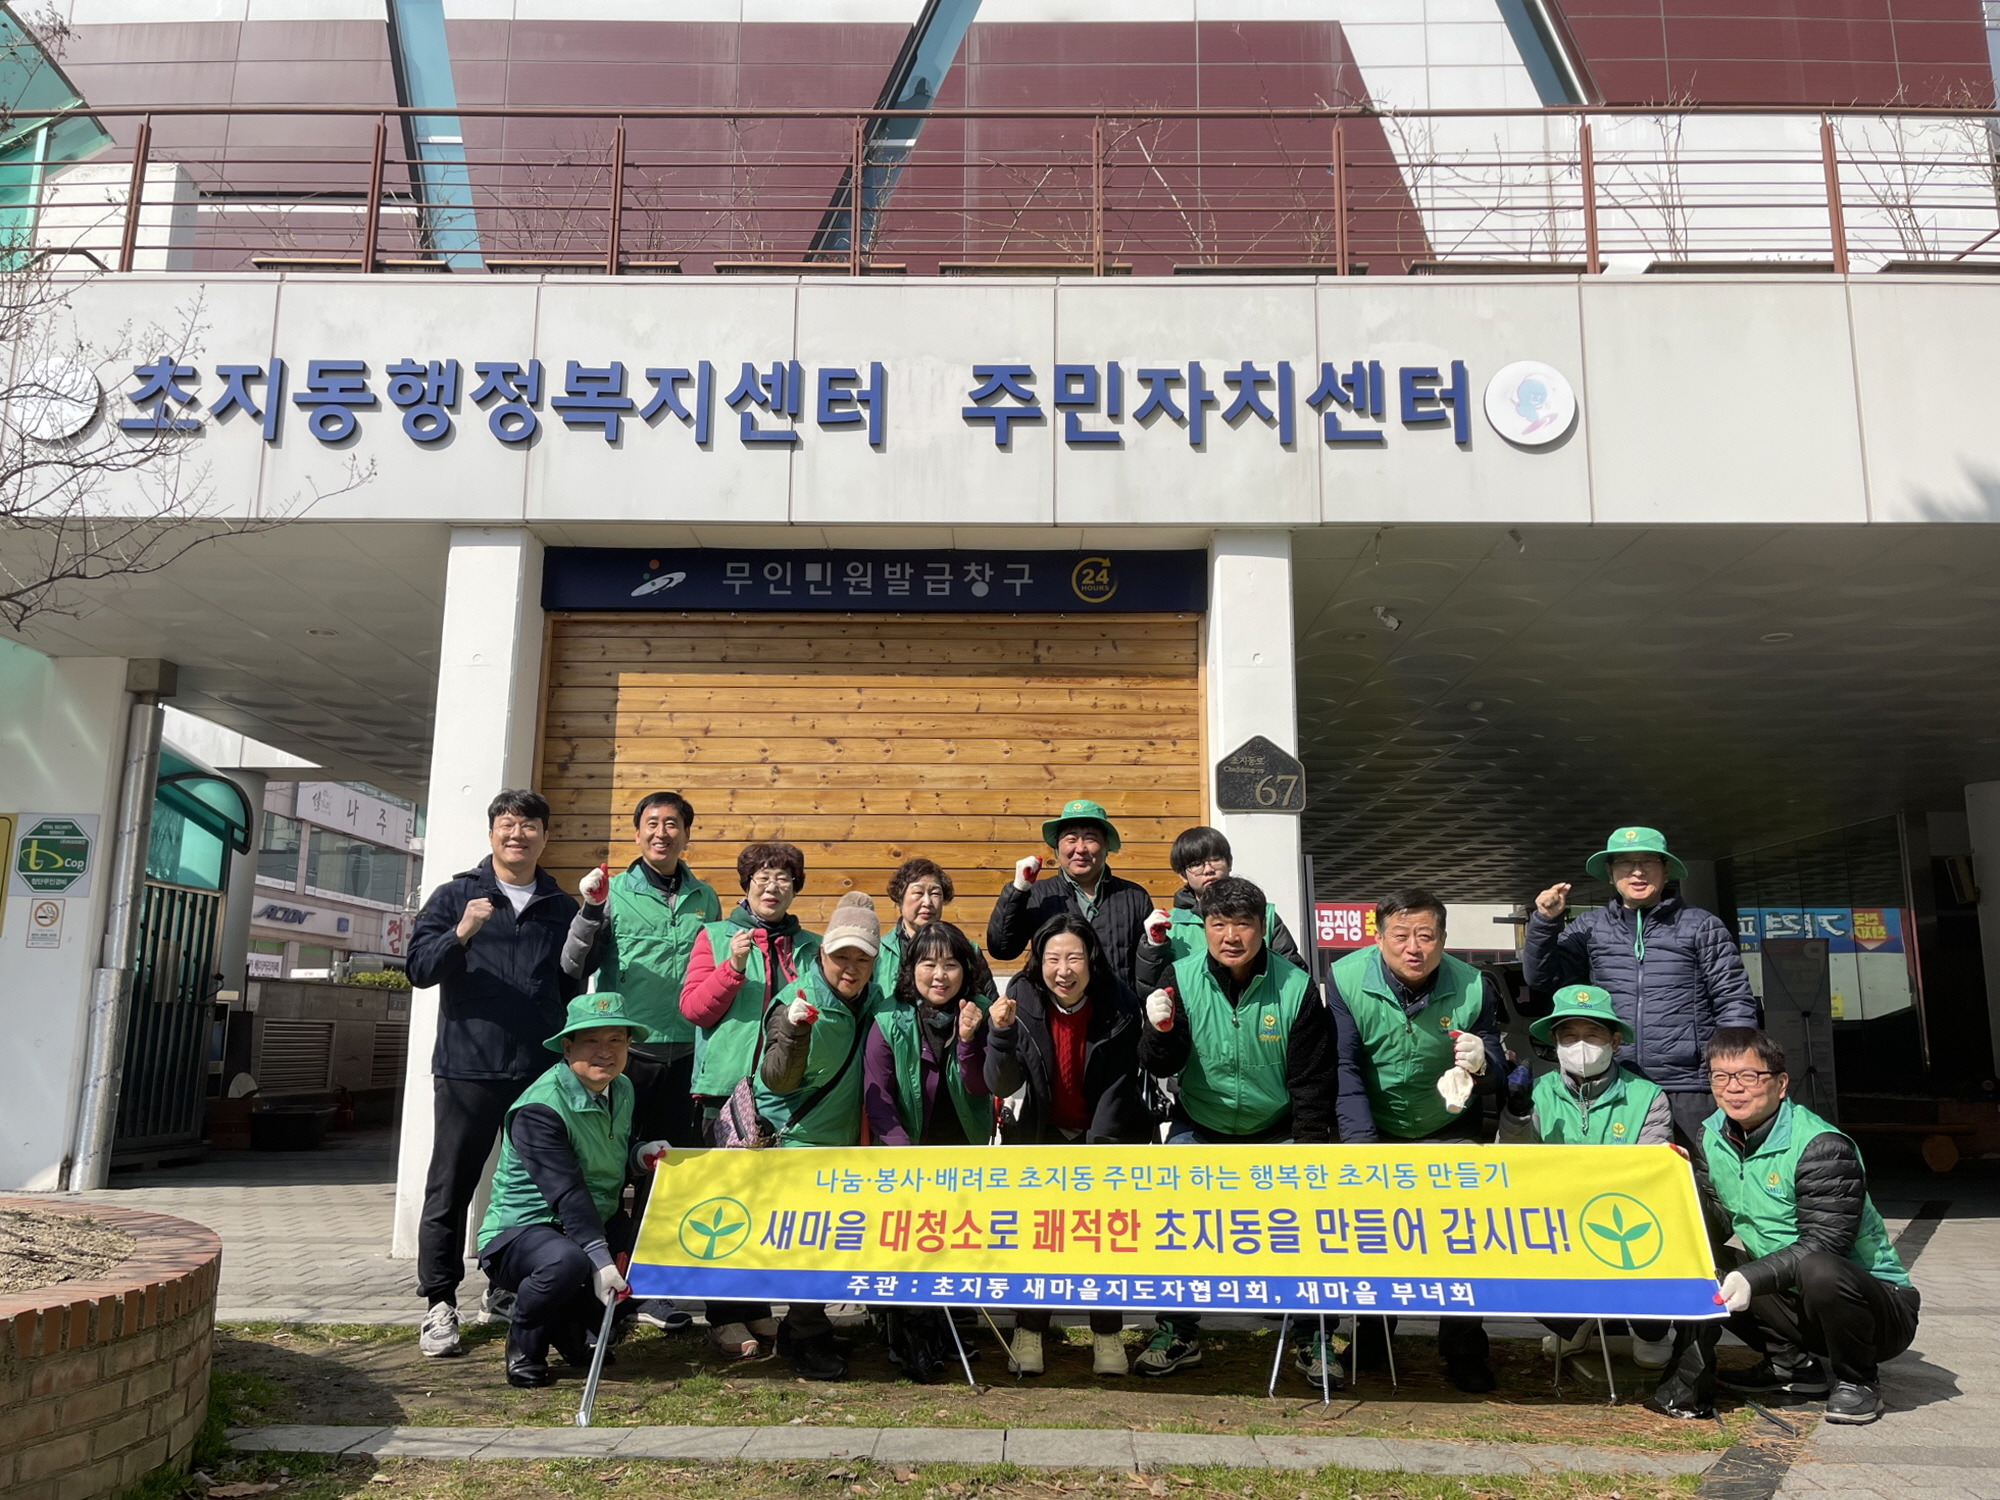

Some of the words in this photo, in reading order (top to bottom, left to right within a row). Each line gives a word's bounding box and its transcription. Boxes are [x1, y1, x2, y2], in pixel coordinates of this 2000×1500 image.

[121, 356, 884, 444] 초지동행정복지센터
[962, 361, 1468, 445] 주민자치센터
[722, 561, 1035, 599] 무인민원발급창구
[1081, 568, 1110, 585] 24
[1255, 775, 1299, 807] 67
[1315, 909, 1362, 942] 공직영
[1017, 1165, 1095, 1192] 초지동
[1102, 1165, 1181, 1191] 주민과
[1188, 1165, 1241, 1191] 하는
[1249, 1164, 1329, 1191] 행복한
[1337, 1163, 1419, 1190] 초지동
[1427, 1161, 1509, 1189] 만들기
[760, 1210, 866, 1251] 새마을
[879, 1209, 1019, 1253] 대청소로
[1032, 1209, 1141, 1253] 쾌적한
[1155, 1208, 1300, 1255] 초지동을
[1315, 1207, 1427, 1255] 만들어
[1440, 1207, 1572, 1255] 갑시다!
[846, 1275, 899, 1298] 주관
[930, 1275, 1011, 1300] 초지동
[1022, 1276, 1282, 1305] 새마을지도자협의회,
[1295, 1280, 1378, 1306] 새마을
[1390, 1281, 1476, 1308] 부녀회
